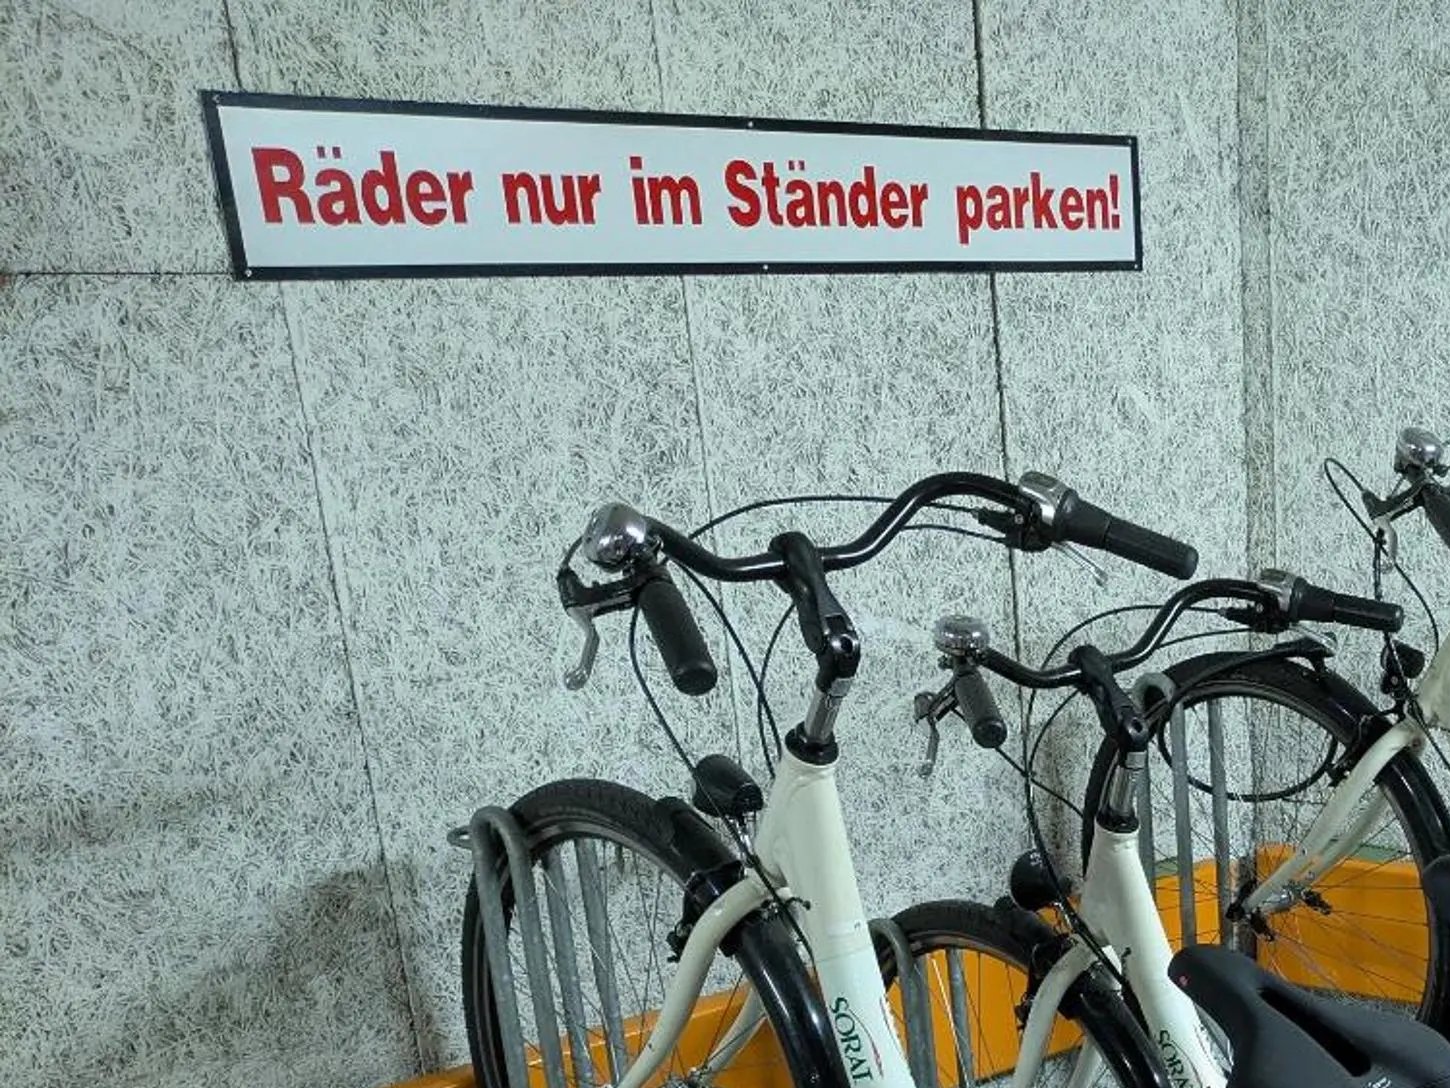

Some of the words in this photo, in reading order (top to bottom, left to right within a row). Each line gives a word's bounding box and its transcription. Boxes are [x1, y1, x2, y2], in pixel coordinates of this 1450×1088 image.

[254, 149, 472, 224] Räder
[502, 174, 599, 224] nur
[631, 157, 700, 224] im
[725, 160, 928, 228] Ständer
[956, 175, 1119, 244] parken!
[829, 996, 874, 1080] SORAT
